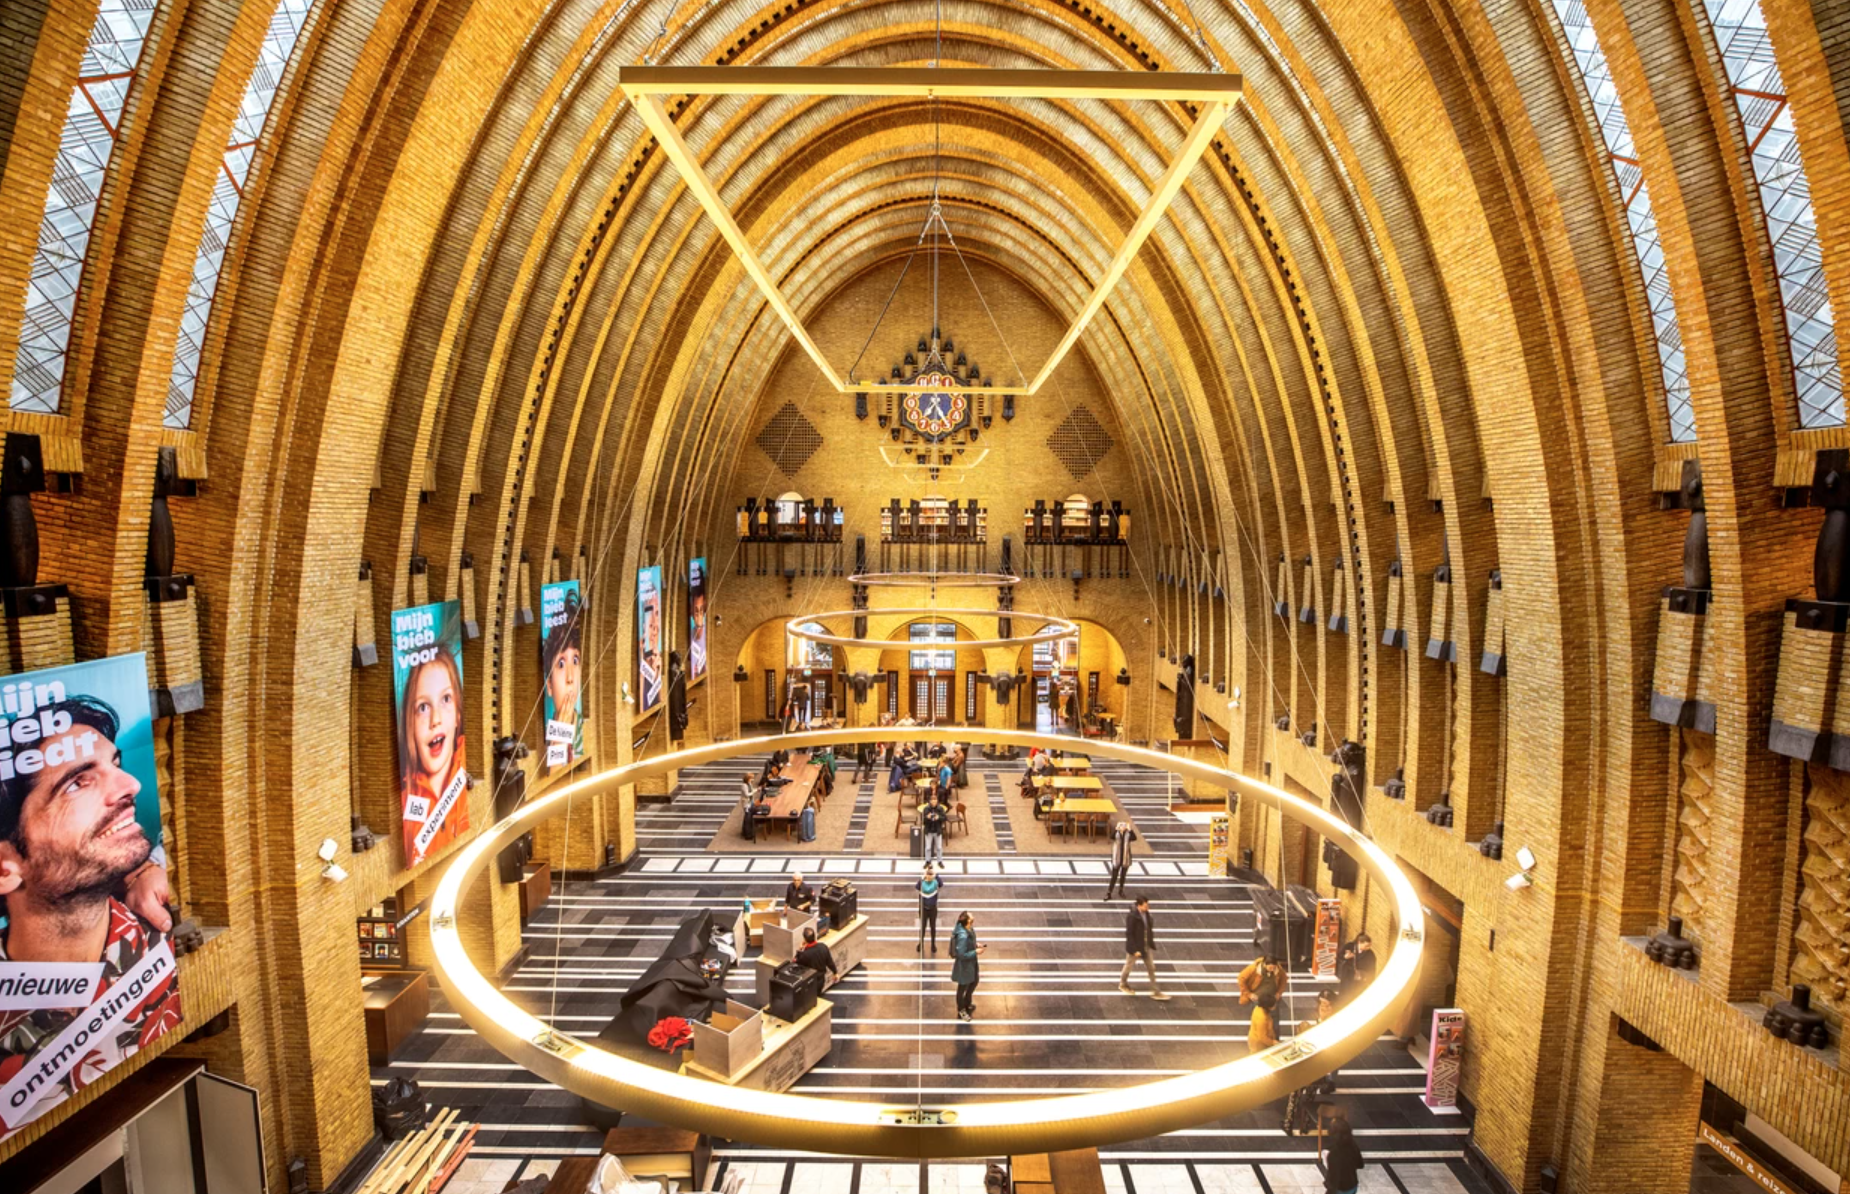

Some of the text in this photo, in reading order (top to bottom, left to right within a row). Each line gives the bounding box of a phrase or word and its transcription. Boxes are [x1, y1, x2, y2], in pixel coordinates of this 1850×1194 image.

[396, 611, 434, 633] Mijn
[396, 628, 435, 651] bieb
[398, 646, 439, 669] voor
[0, 680, 66, 718] ijn
[409, 801, 424, 816] lab
[421, 777, 463, 844] experiment
[0, 972, 89, 996] nieuwe
[10, 957, 167, 1108] ontmoetingen
[1703, 1128, 1744, 1166] Landen
[1746, 1162, 1755, 1174] &
